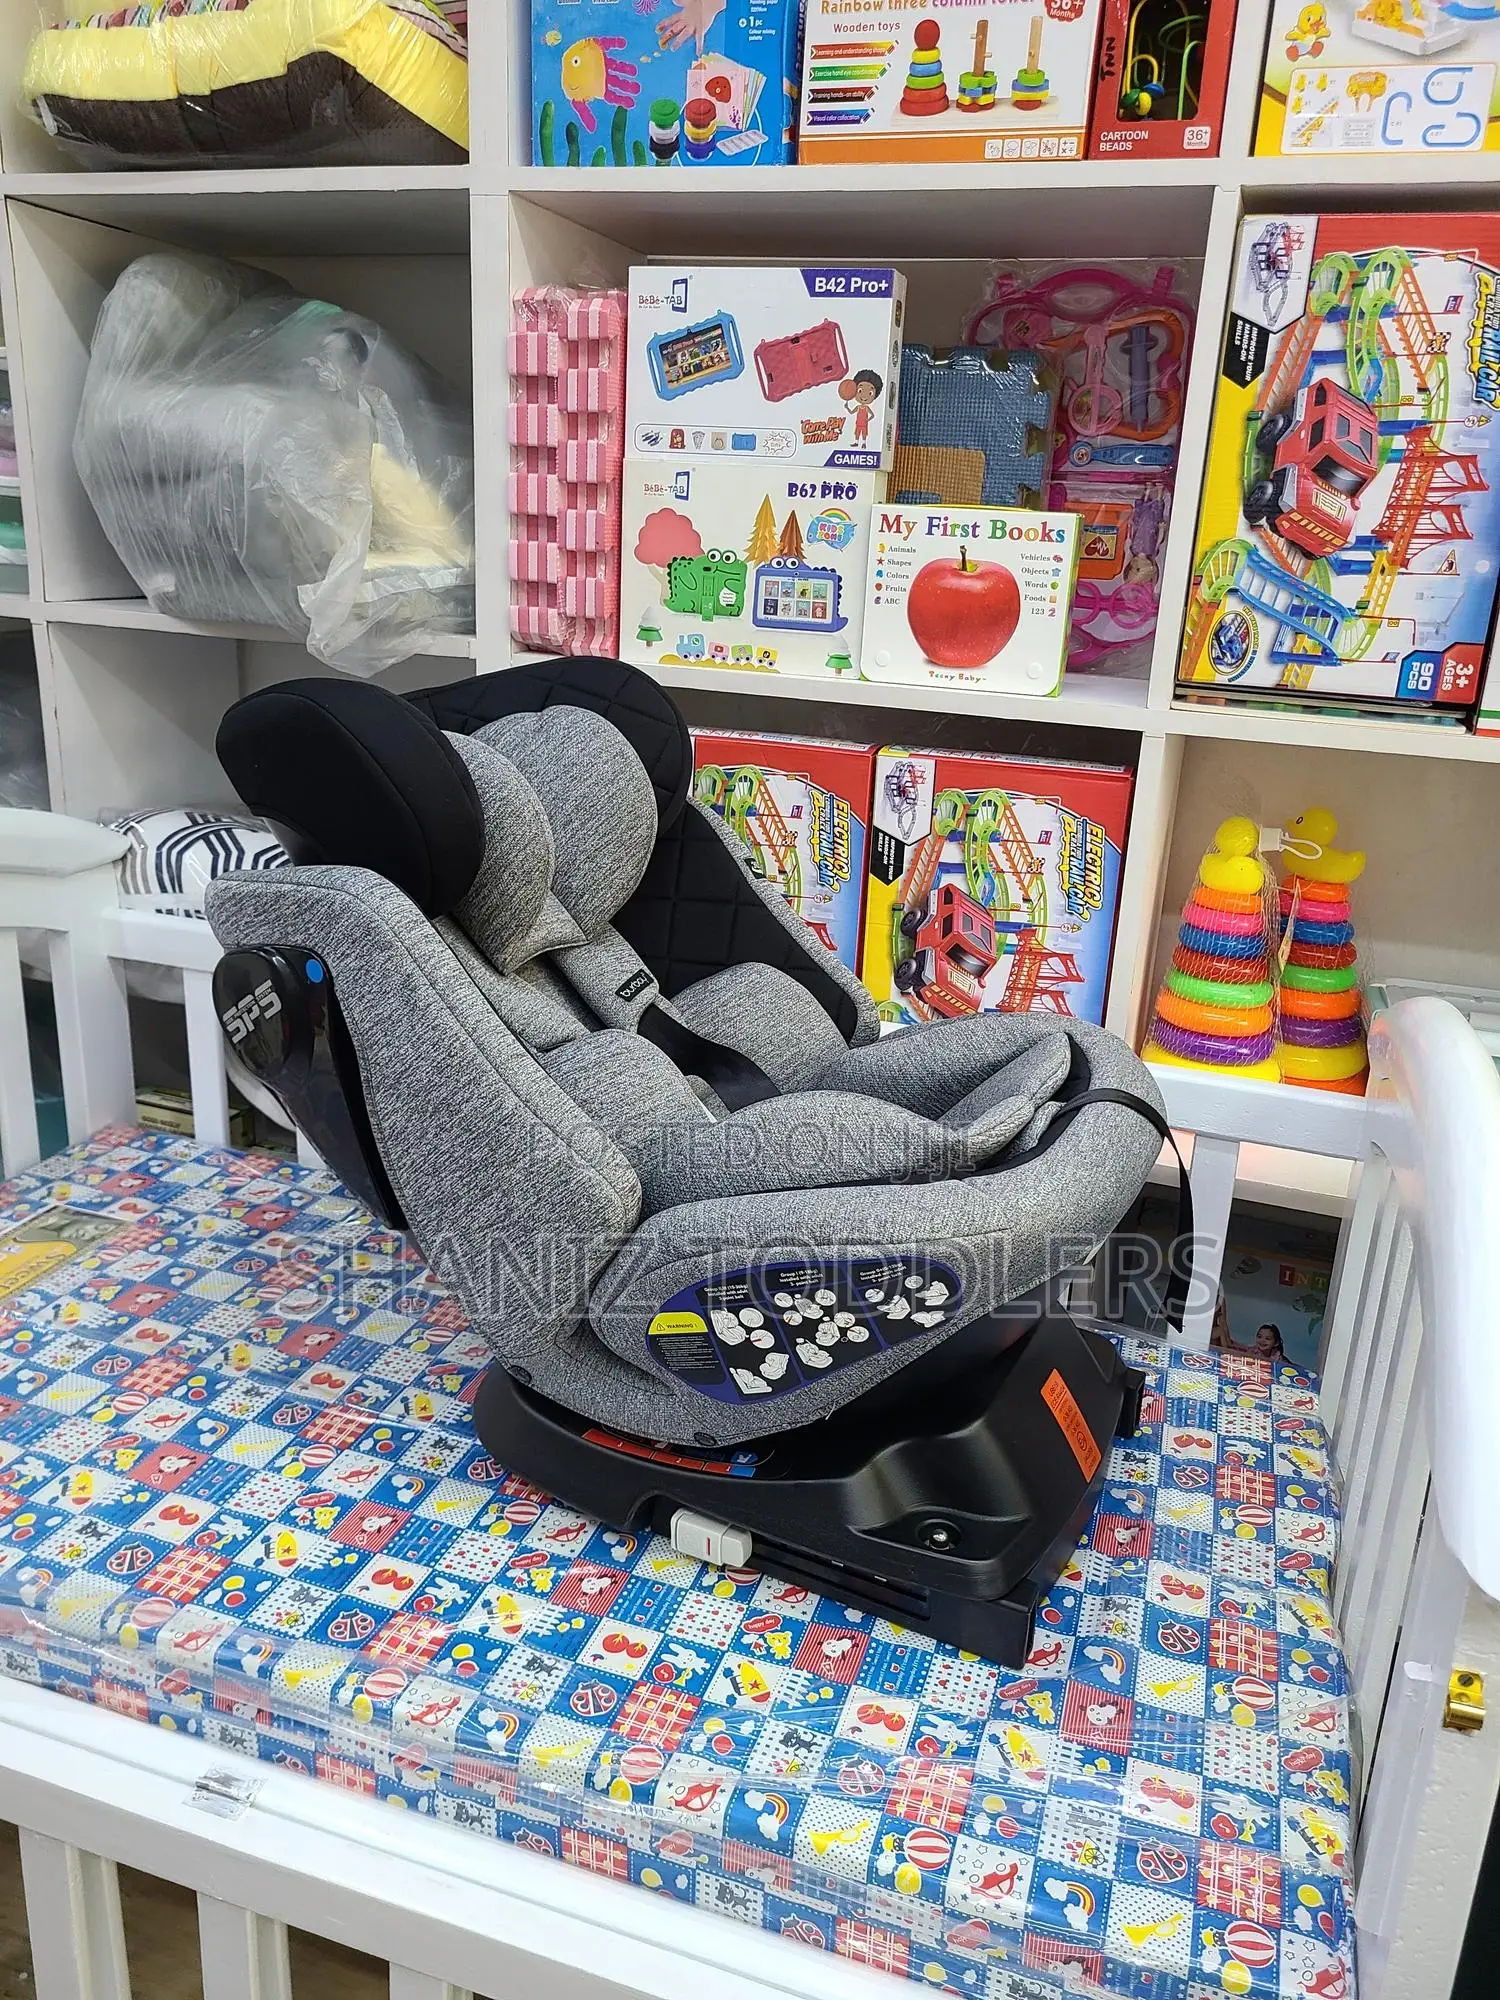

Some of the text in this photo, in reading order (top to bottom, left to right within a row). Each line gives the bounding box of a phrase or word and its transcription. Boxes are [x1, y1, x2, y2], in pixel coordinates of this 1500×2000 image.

[821, 0, 882, 14] Rainbow
[1050, 8, 1076, 18] Months
[833, 21, 901, 33] Wooden toys
[1100, 131, 1149, 140] CARTOON
[1187, 130, 1208, 141] 36+
[1099, 142, 1133, 152] BEADS
[814, 277, 889, 293] B42 Pro+
[1483, 295, 1494, 326] CRACK
[1234, 319, 1244, 346] SKILLS
[1240, 323, 1251, 362] HANDS-ON
[1245, 327, 1258, 381] IMPROVE YOUR
[1476, 366, 1500, 403] CAR
[834, 454, 877, 466] GAMES!
[787, 482, 857, 500] B62 PRO
[819, 523, 845, 534] KIDS
[878, 514, 1066, 544] My First Books
[888, 545, 917, 554] Animals
[887, 558, 912, 567] Shapes
[1020, 553, 1051, 562] Vehicles
[886, 571, 910, 580] Colors
[1021, 567, 1049, 575] Objects
[885, 585, 907, 593] Fruits
[1025, 580, 1048, 589] Words
[884, 597, 901, 605] ABC
[1024, 594, 1046, 602] Foods
[1031, 607, 1045, 615] 123
[958, 673, 982, 684] Baby
[1407, 661, 1420, 690] PCS
[1418, 662, 1434, 691] 90
[1441, 659, 1456, 691] AGES
[1456, 663, 1474, 688] 3+
[833, 799, 849, 874] ELECTRIC
[819, 830, 834, 886] RAIL CAR
[1085, 823, 1103, 904] ELECTRIC
[1068, 856, 1085, 914] RAIL CAR
[222, 979, 282, 1044] SPS
